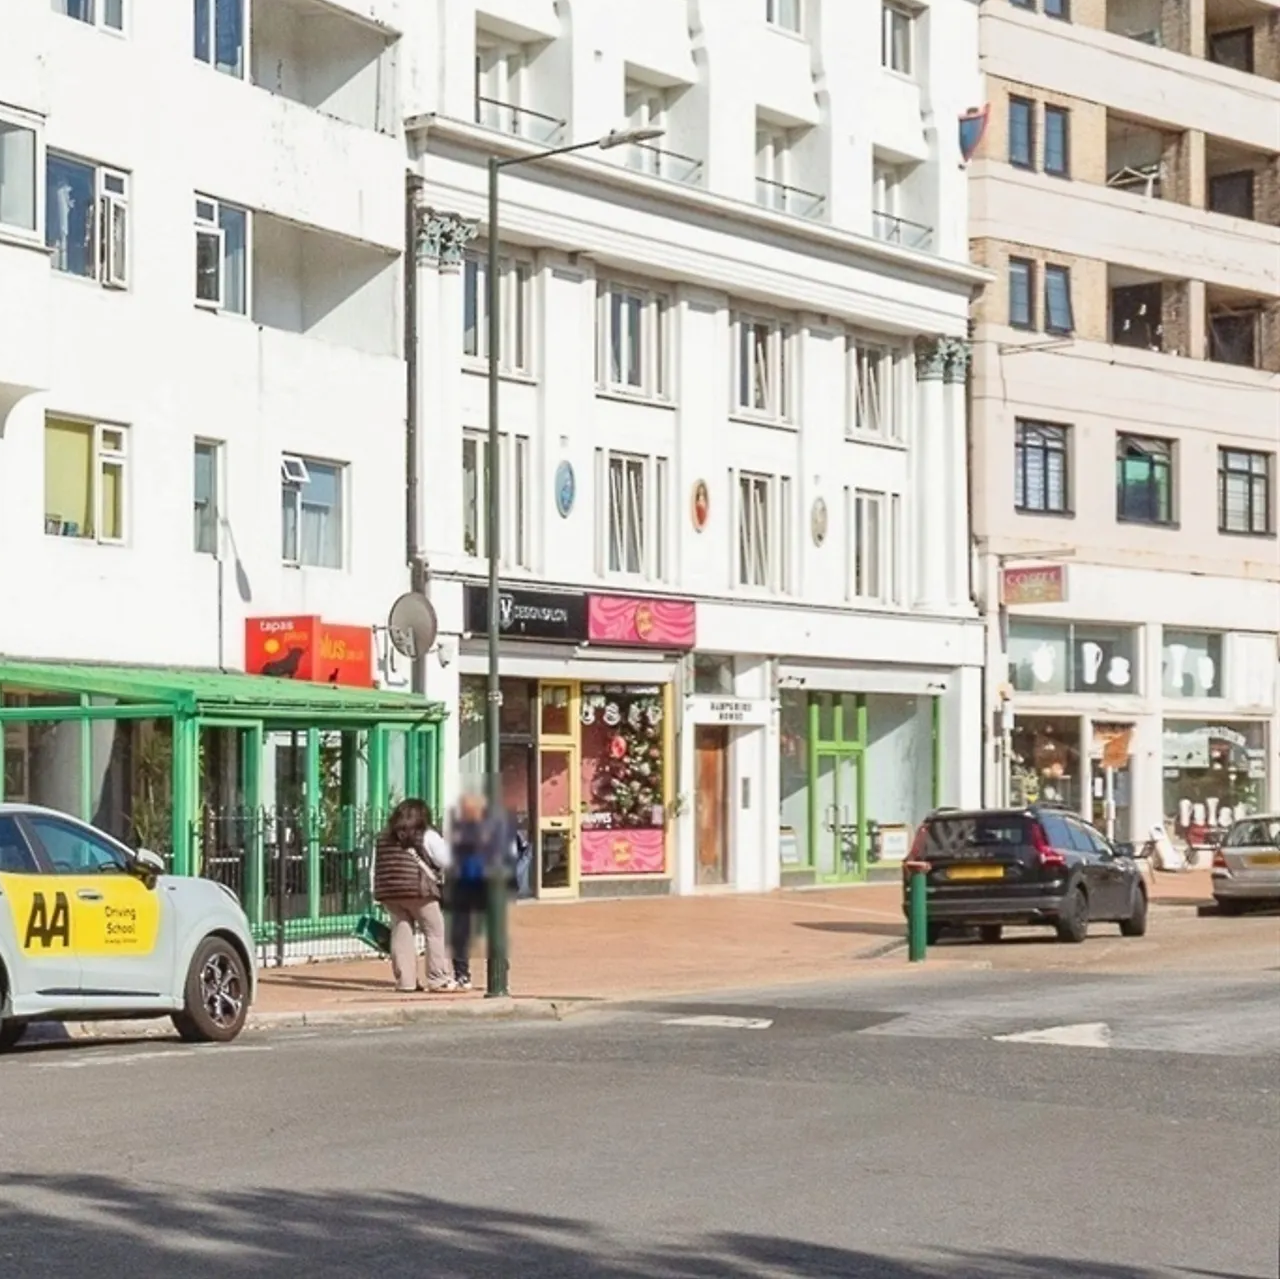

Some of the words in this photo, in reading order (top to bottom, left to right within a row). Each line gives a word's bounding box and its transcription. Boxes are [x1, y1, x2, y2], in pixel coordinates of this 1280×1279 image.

[260, 621, 294, 633] tapas
[24, 892, 69, 948] AA
[104, 905, 136, 921] Driving
[106, 922, 136, 934] School
